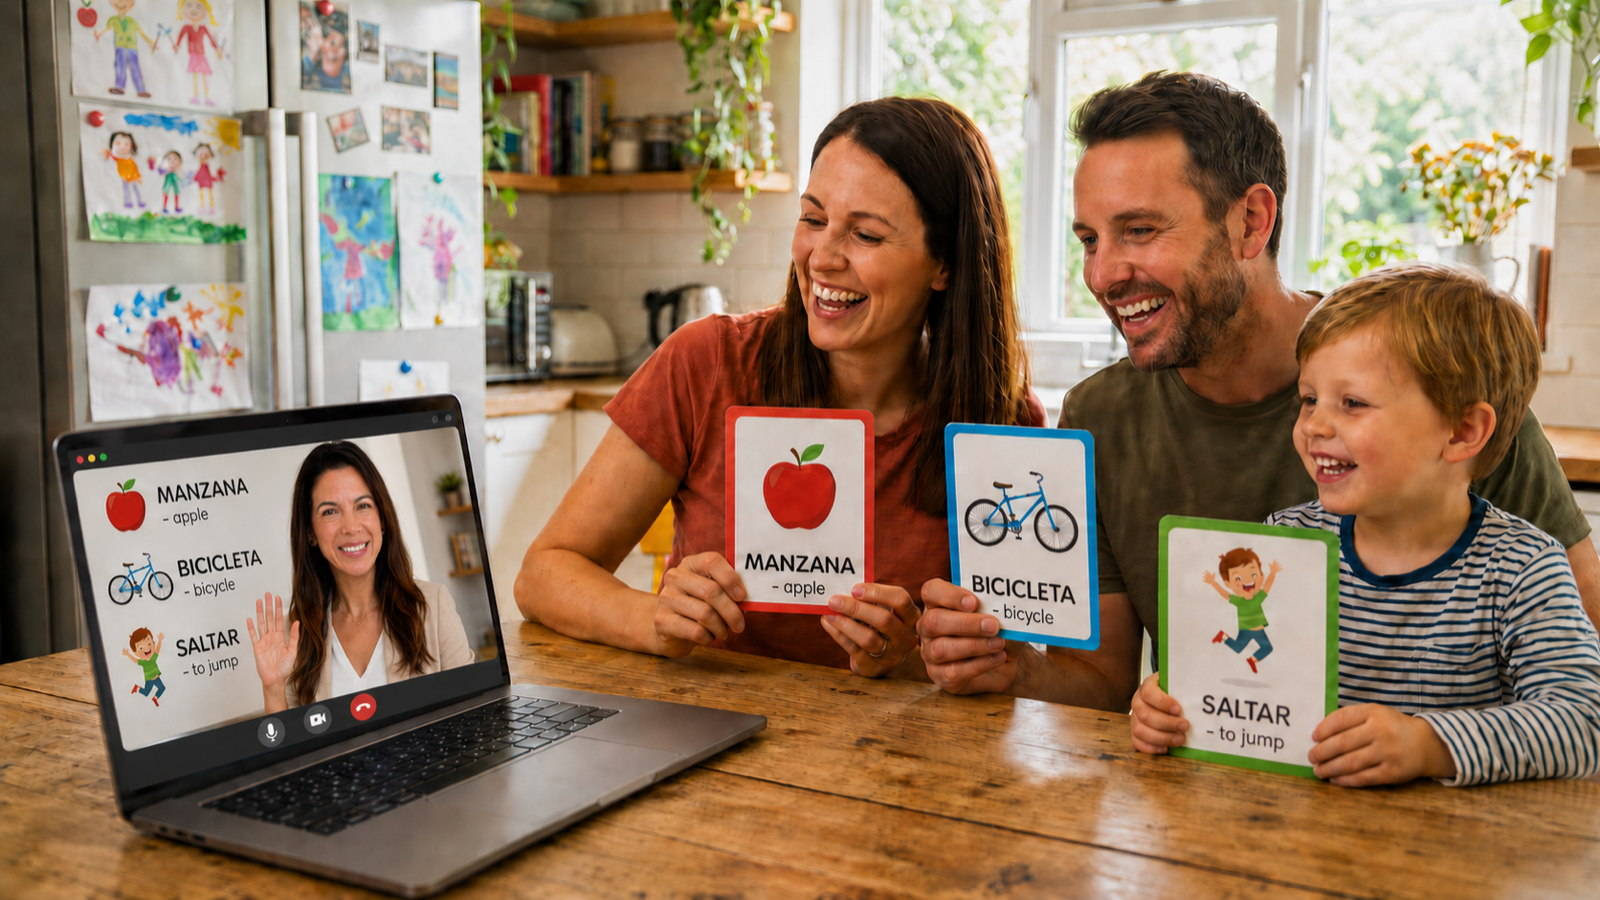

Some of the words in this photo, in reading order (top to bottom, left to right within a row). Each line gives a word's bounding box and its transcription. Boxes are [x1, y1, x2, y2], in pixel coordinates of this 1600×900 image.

[157, 477, 249, 504] MANZANA
[173, 507, 209, 527] apple
[177, 549, 263, 578] BICICLETA
[744, 552, 856, 575] MANZANA
[193, 577, 236, 598] bicycle
[783, 580, 826, 599] apple
[971, 574, 1076, 605] BICICLETA
[1003, 603, 1054, 626] bicycle
[175, 628, 240, 658] SALTAR
[192, 662, 206, 676] to
[207, 656, 239, 677] jump
[1202, 694, 1291, 727] SALTAR
[1219, 726, 1236, 742] to
[1240, 728, 1285, 754] jump
